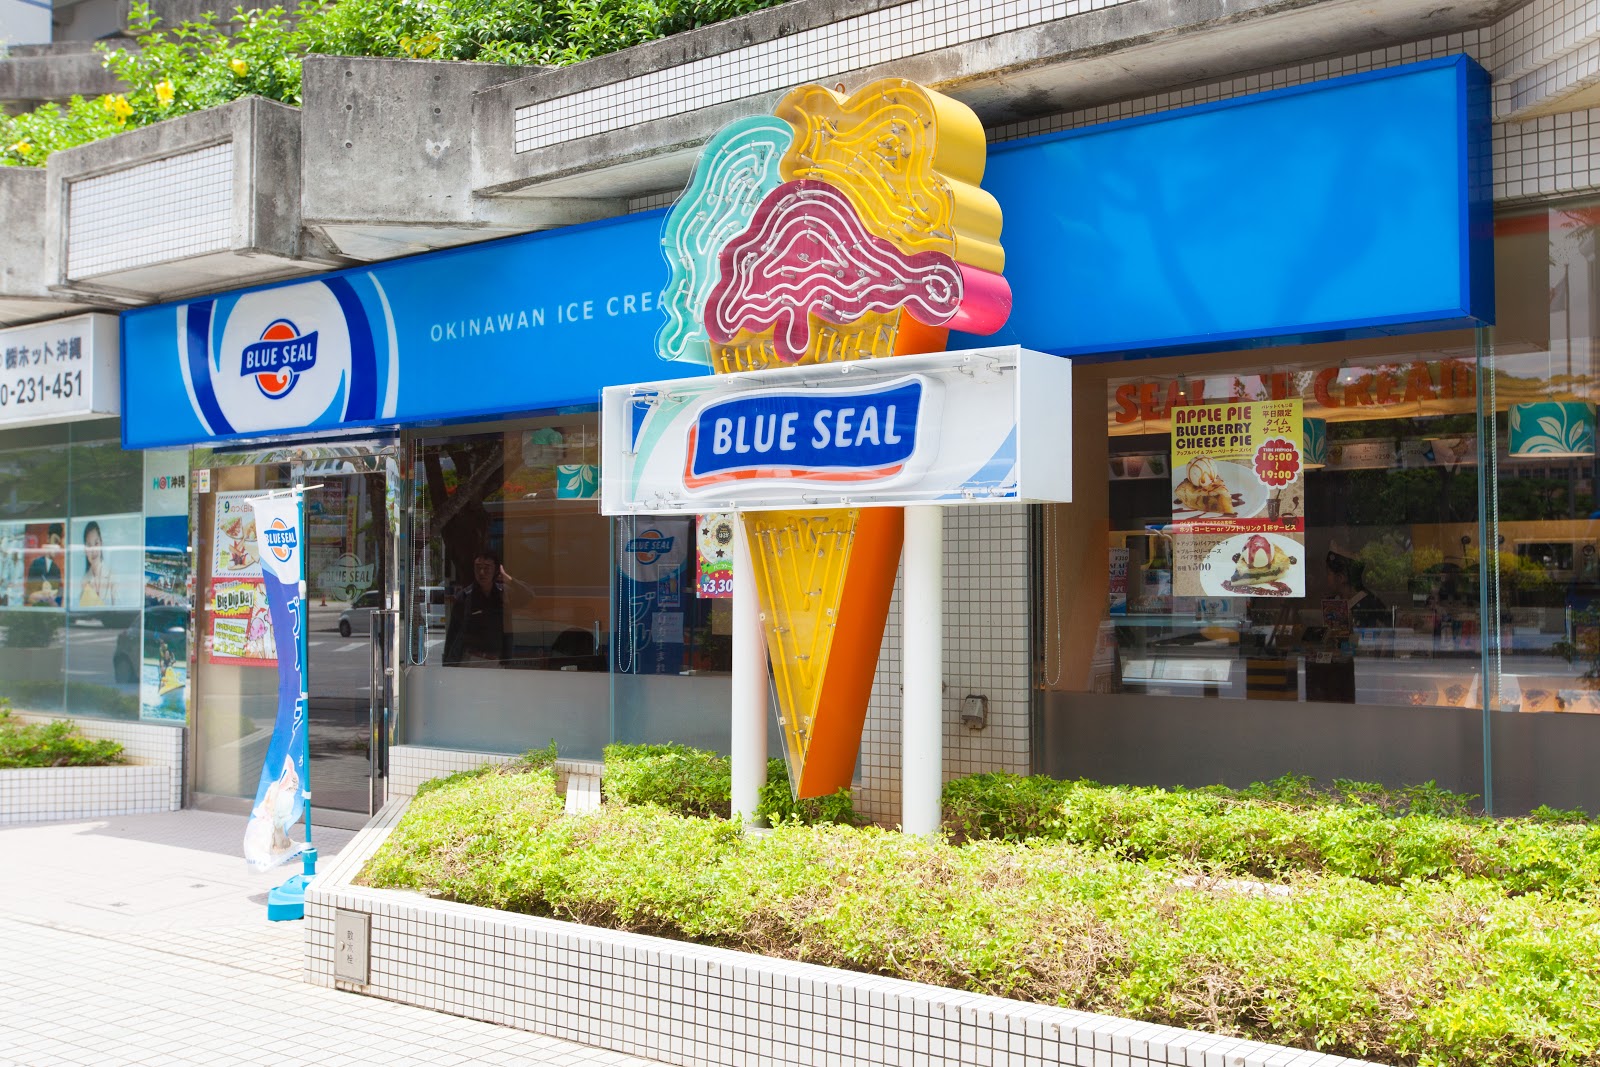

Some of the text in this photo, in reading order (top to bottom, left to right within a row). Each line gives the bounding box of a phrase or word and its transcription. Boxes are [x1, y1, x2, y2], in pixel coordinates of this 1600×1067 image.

[430, 308, 545, 342] OKINAWAN
[558, 301, 593, 323] ICE
[246, 342, 314, 368] BLUE SEAL
[1176, 406, 1252, 424] APPLE PIE
[1262, 409, 1292, 418] 平日限定
[1266, 418, 1289, 426] タイム
[712, 404, 902, 455] BLUE SEAL
[1176, 422, 1252, 437] BLUEBERRY
[1262, 426, 1292, 434] サービス
[1176, 435, 1252, 449] CHEESE PIE
[1262, 453, 1293, 461] 16:00
[1261, 470, 1292, 479] 19:00
[281, 532, 296, 543] SEAL
[630, 539, 671, 550] BLUE SEAL
[1188, 562, 1212, 571] ¥500
[350, 570, 370, 583] SEAL
[217, 591, 254, 610] Big Dip Day
